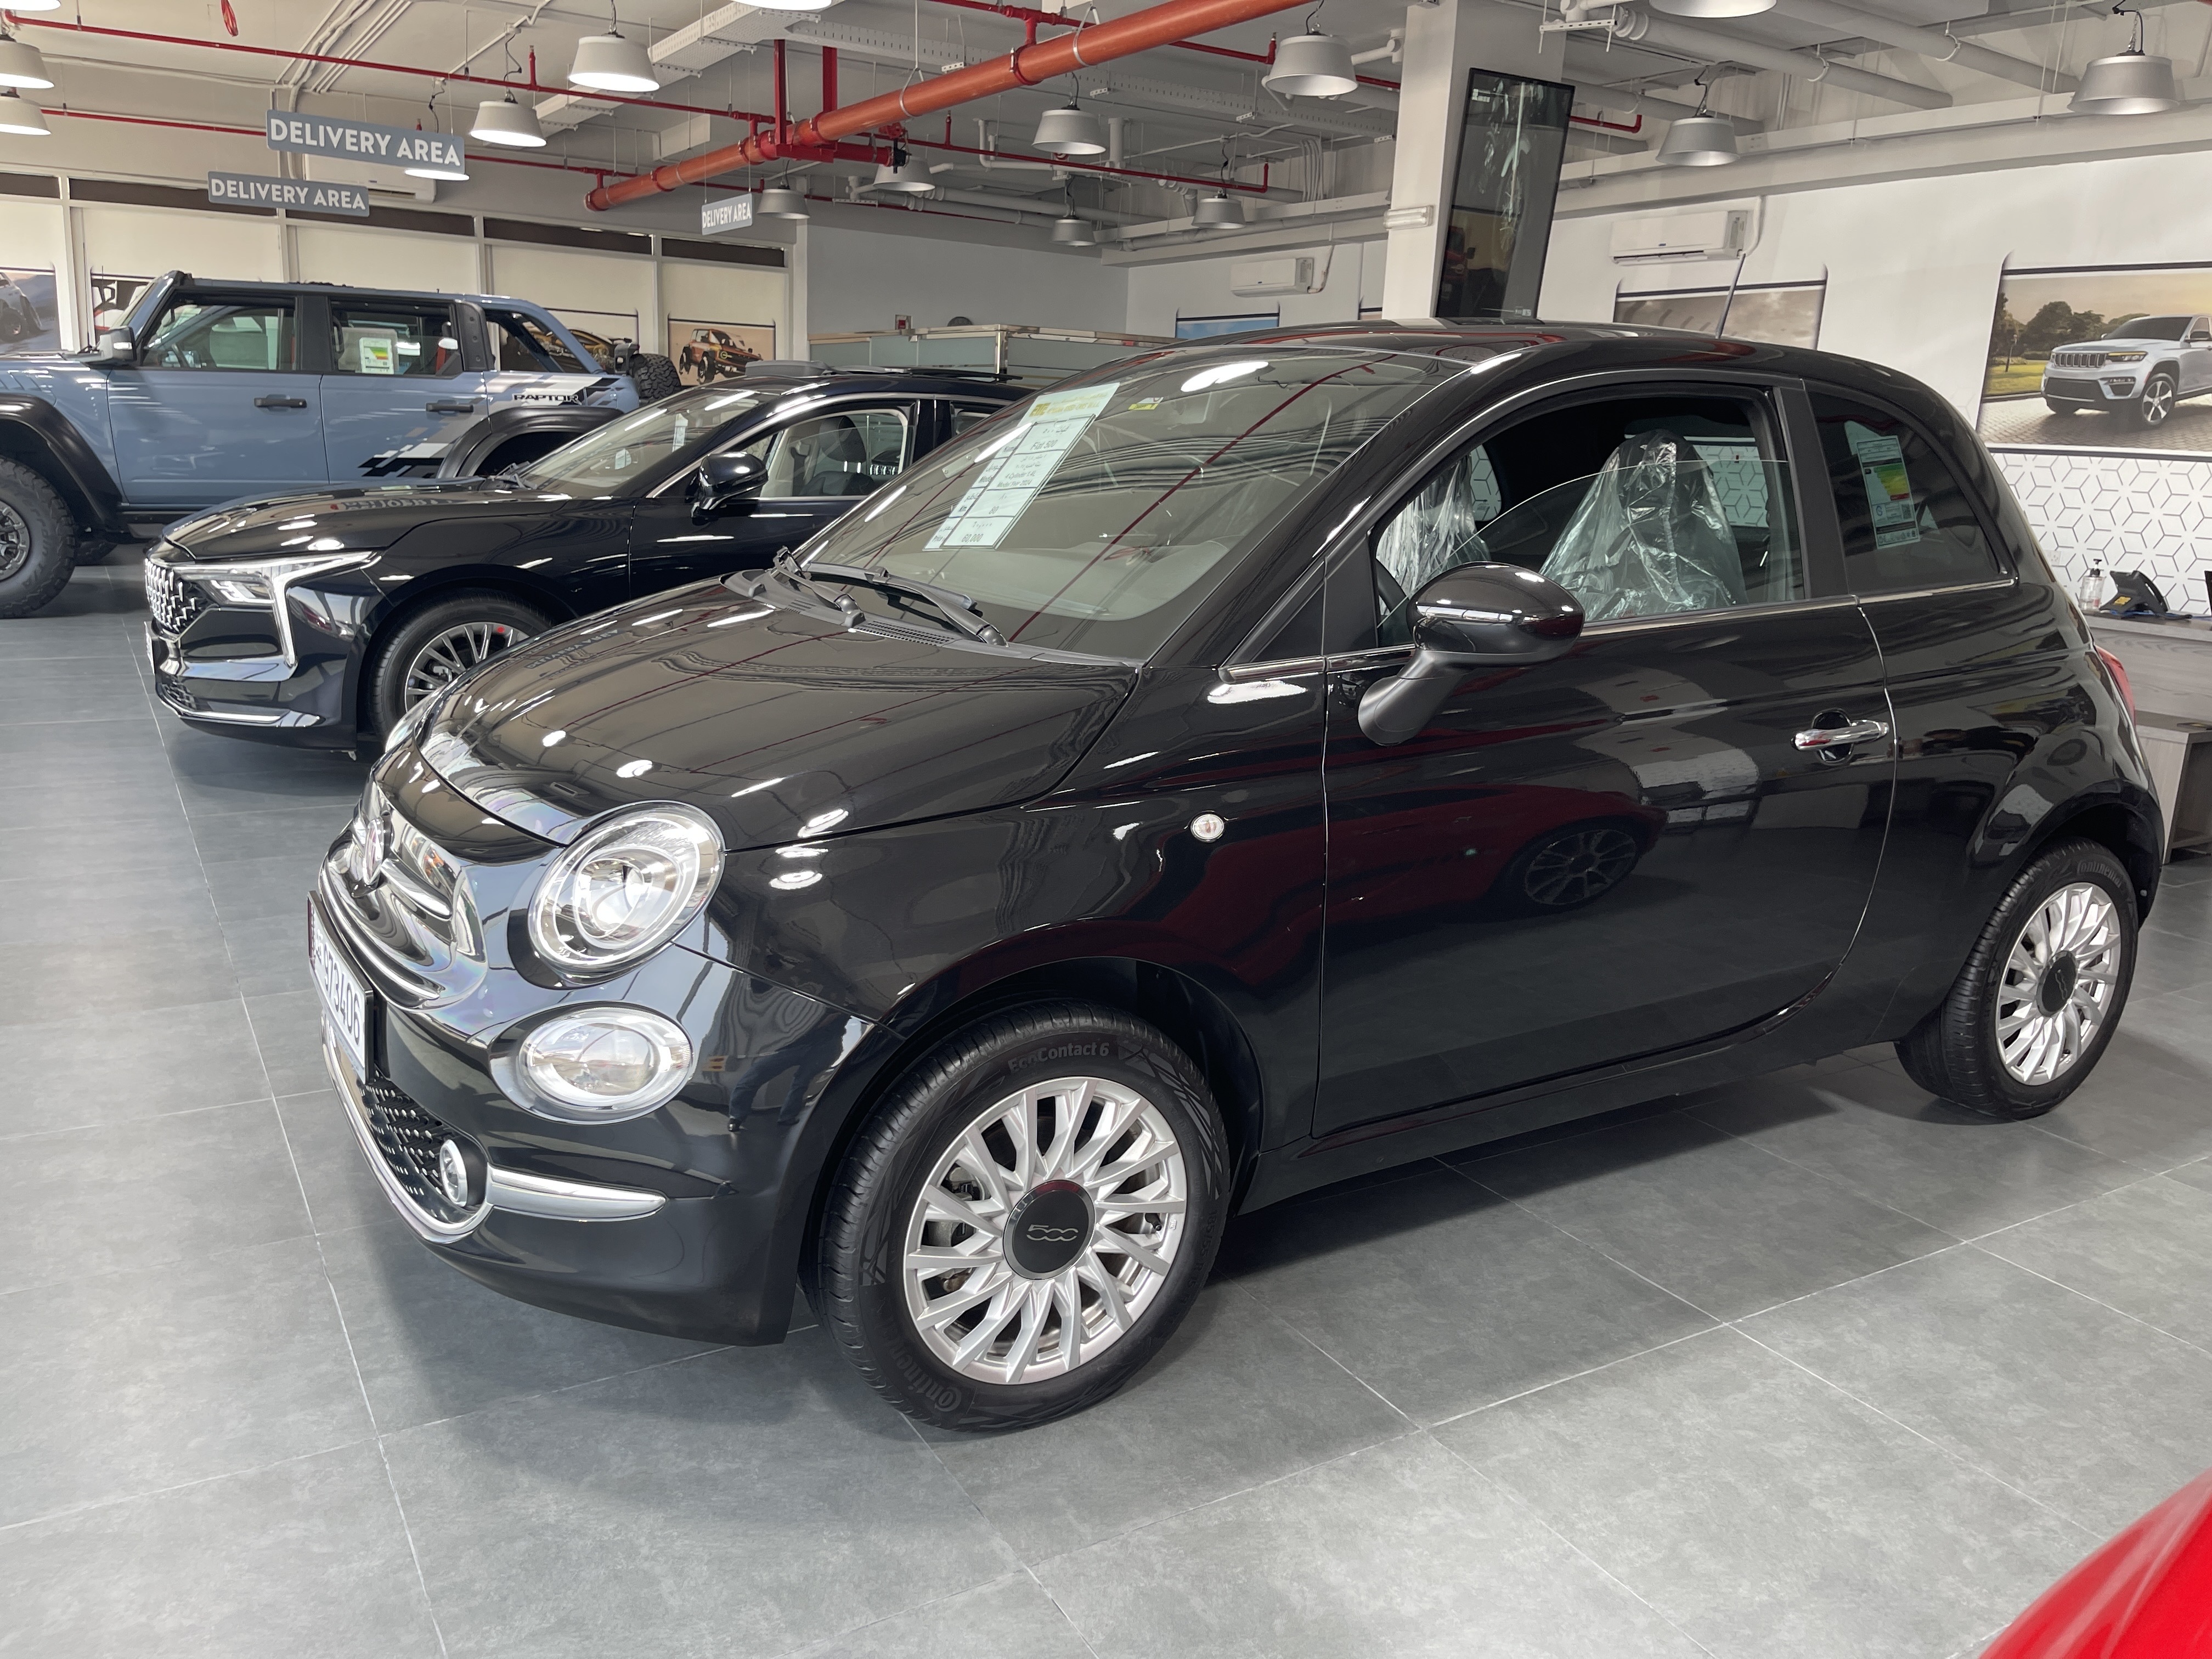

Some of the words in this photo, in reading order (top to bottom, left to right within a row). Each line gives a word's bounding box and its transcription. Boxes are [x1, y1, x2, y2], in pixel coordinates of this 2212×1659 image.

[270, 119, 391, 156] DELIVERY
[397, 138, 460, 166] AREA
[211, 178, 309, 204] DELIVERY
[314, 189, 366, 210] AREA
[702, 205, 732, 228] DELIVERY
[733, 202, 751, 222] AREA
[514, 394, 582, 405] RAPTOR
[1030, 441, 1045, 450] Fiat
[1043, 439, 1058, 448] 500
[989, 506, 1000, 515] 80
[961, 533, 984, 543] 60,000
[324, 944, 360, 1046] 973406
[1008, 1042, 1097, 1073] EcoContact
[1099, 1042, 1109, 1056] 6
[1026, 1224, 1079, 1241] 500
[881, 1330, 962, 1412] Continen
